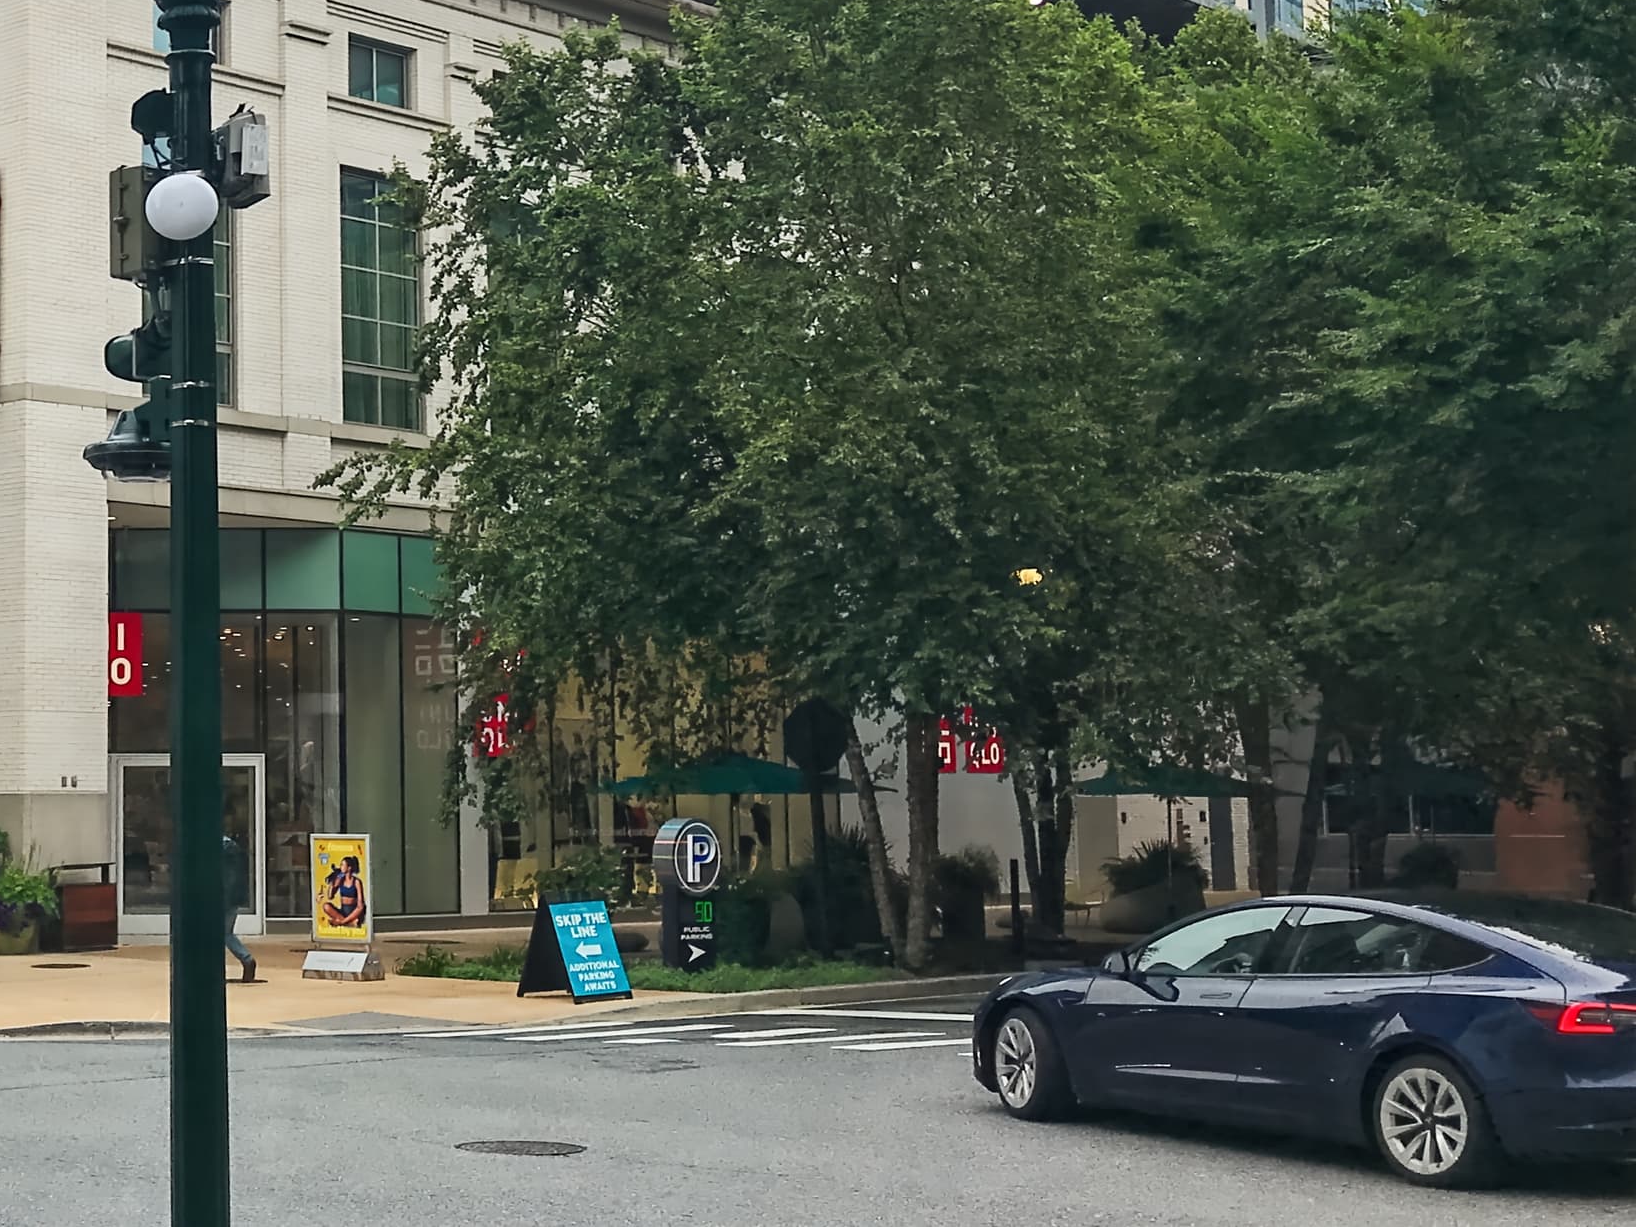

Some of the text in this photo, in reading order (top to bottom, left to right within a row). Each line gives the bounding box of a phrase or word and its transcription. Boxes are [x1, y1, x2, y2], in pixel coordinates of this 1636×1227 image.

[687, 834, 716, 882] P
[555, 912, 607, 927] SKIP THE
[570, 926, 598, 938] LINE
[569, 960, 620, 972] ADDITIONAL
[578, 970, 615, 982] PARKING
[584, 981, 617, 992] AWAITS
